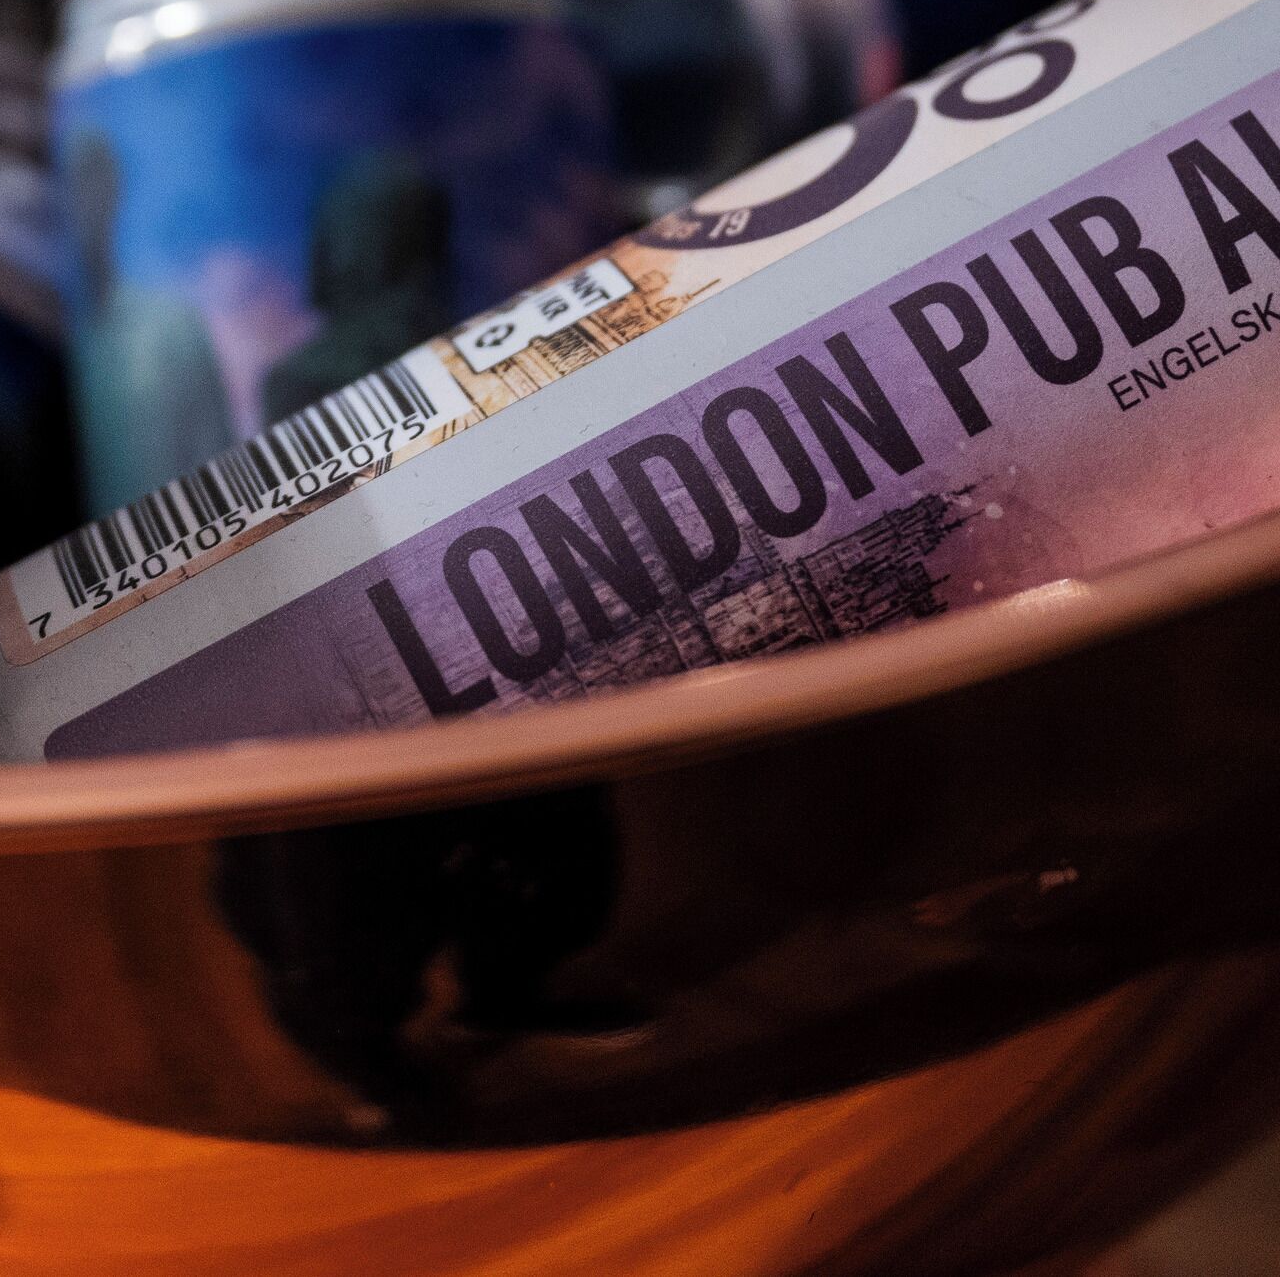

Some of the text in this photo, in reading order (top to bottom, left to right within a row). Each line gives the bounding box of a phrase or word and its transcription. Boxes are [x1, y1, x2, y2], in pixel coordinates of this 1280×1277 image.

[29, 413, 428, 641] 7 340105 402075
[365, 333, 923, 716] LONDON
[889, 195, 1187, 437] PUB
